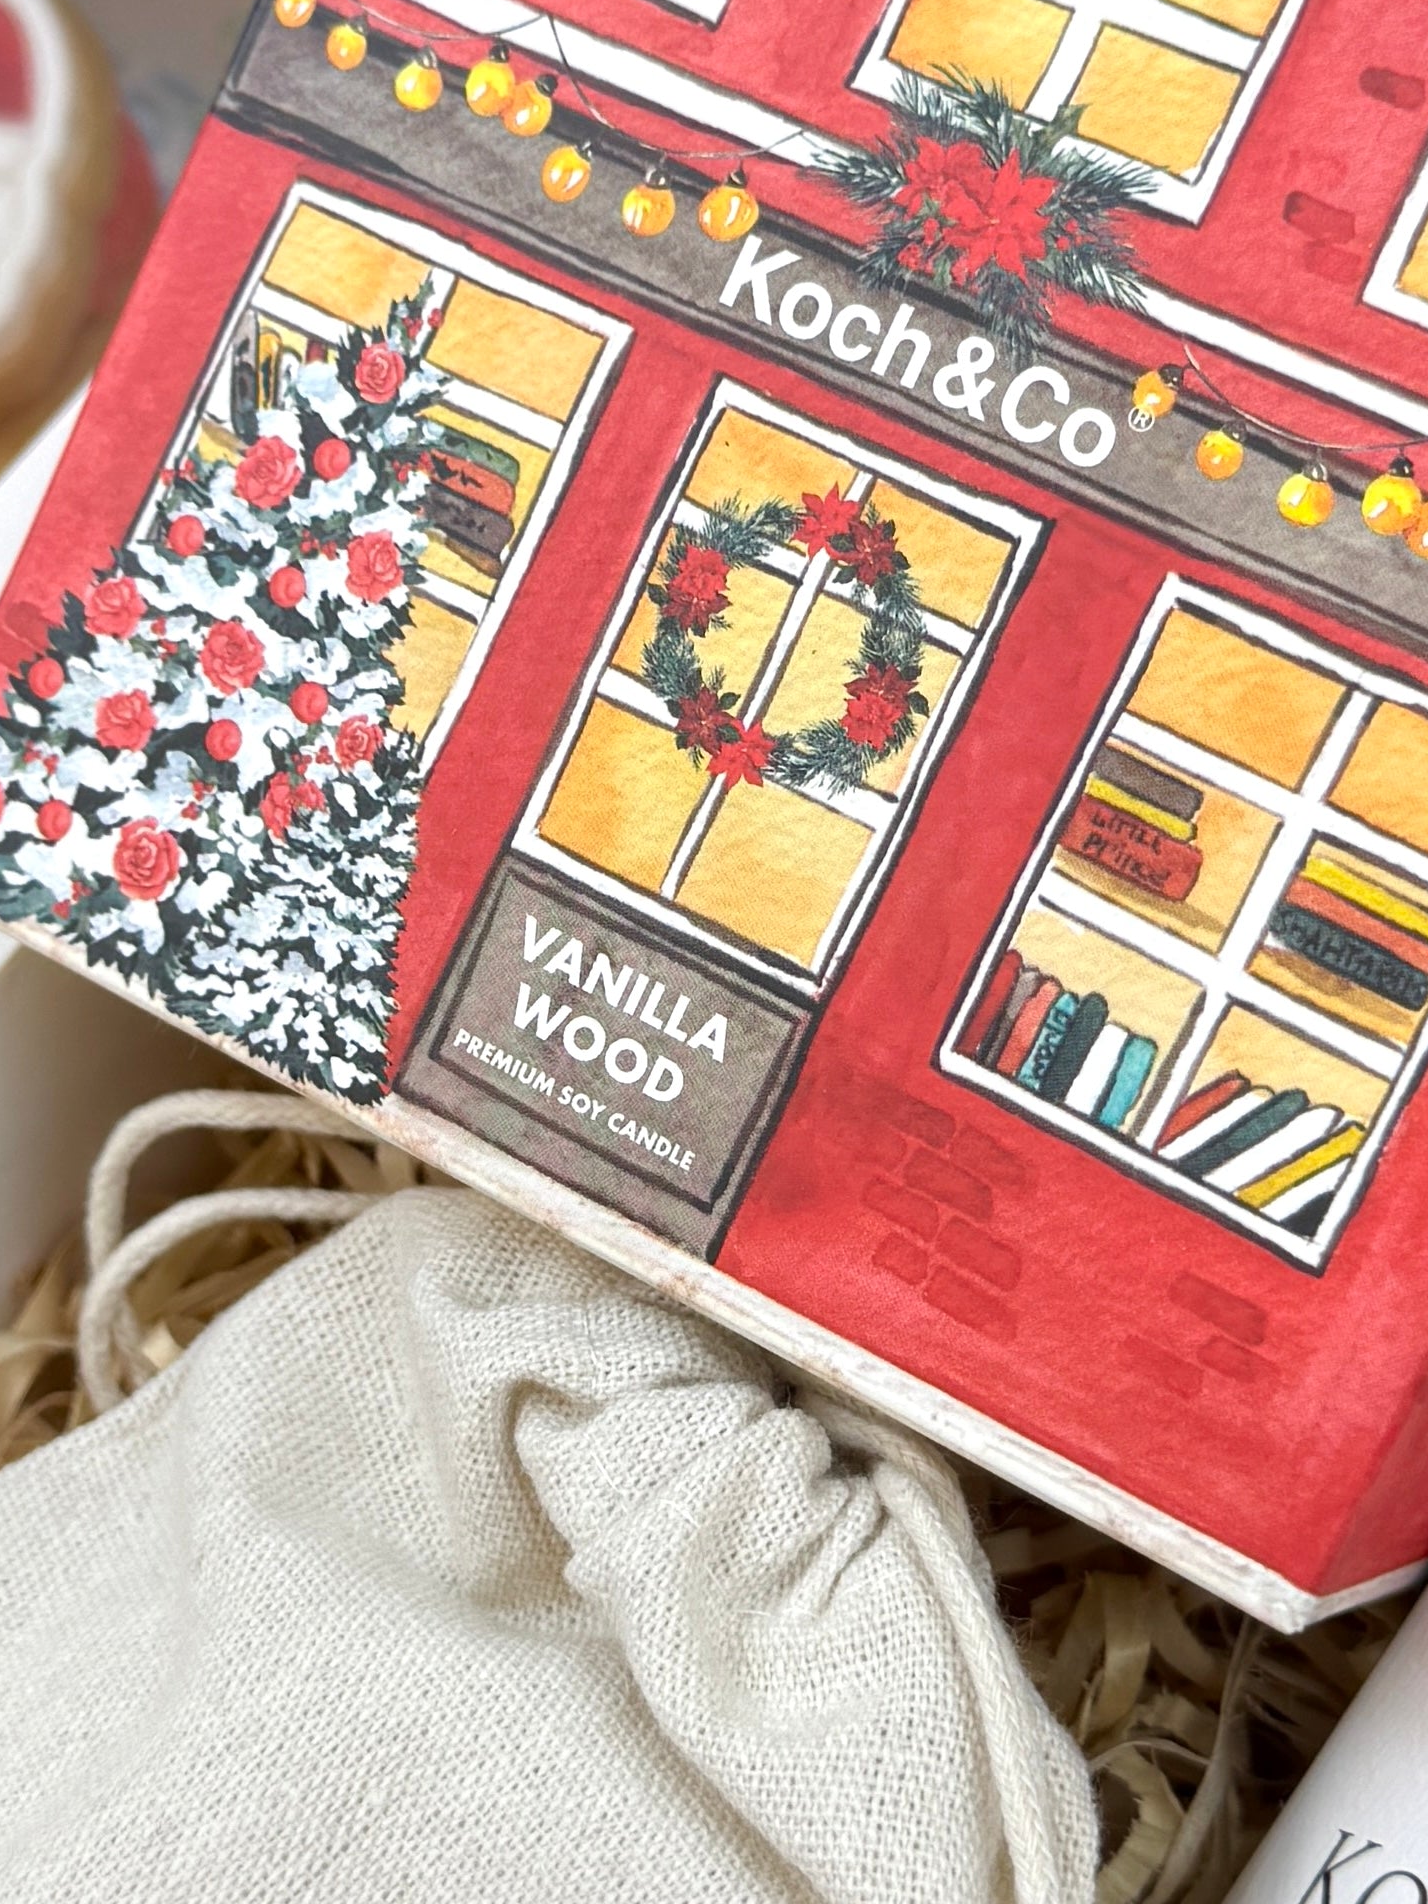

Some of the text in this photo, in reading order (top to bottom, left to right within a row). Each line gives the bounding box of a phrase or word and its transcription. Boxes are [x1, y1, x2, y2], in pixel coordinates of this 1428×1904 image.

[718, 235, 1117, 468] Koch&Co
[514, 981, 684, 1103] WOOD
[524, 914, 729, 1063] VANILLA
[453, 1028, 695, 1172] PREMIUM SOY CANDLE
